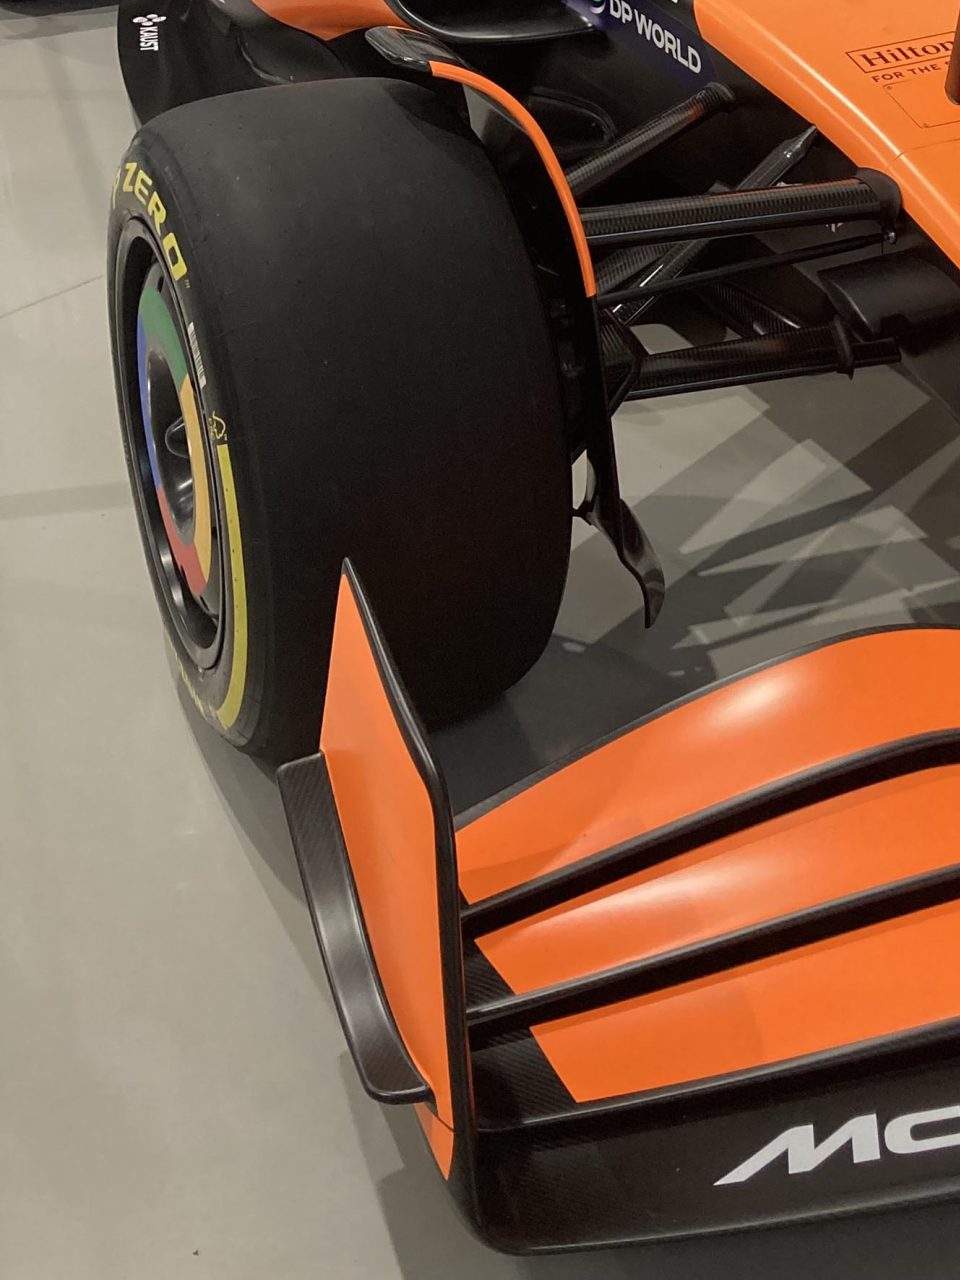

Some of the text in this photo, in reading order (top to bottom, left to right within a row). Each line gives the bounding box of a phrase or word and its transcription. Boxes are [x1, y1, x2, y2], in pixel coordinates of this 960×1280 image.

[139, 26, 159, 51] KAUST
[634, 9, 702, 74] WORLD
[872, 71, 905, 82] FOR
[907, 63, 941, 75] THE
[122, 162, 187, 281] ZERO
